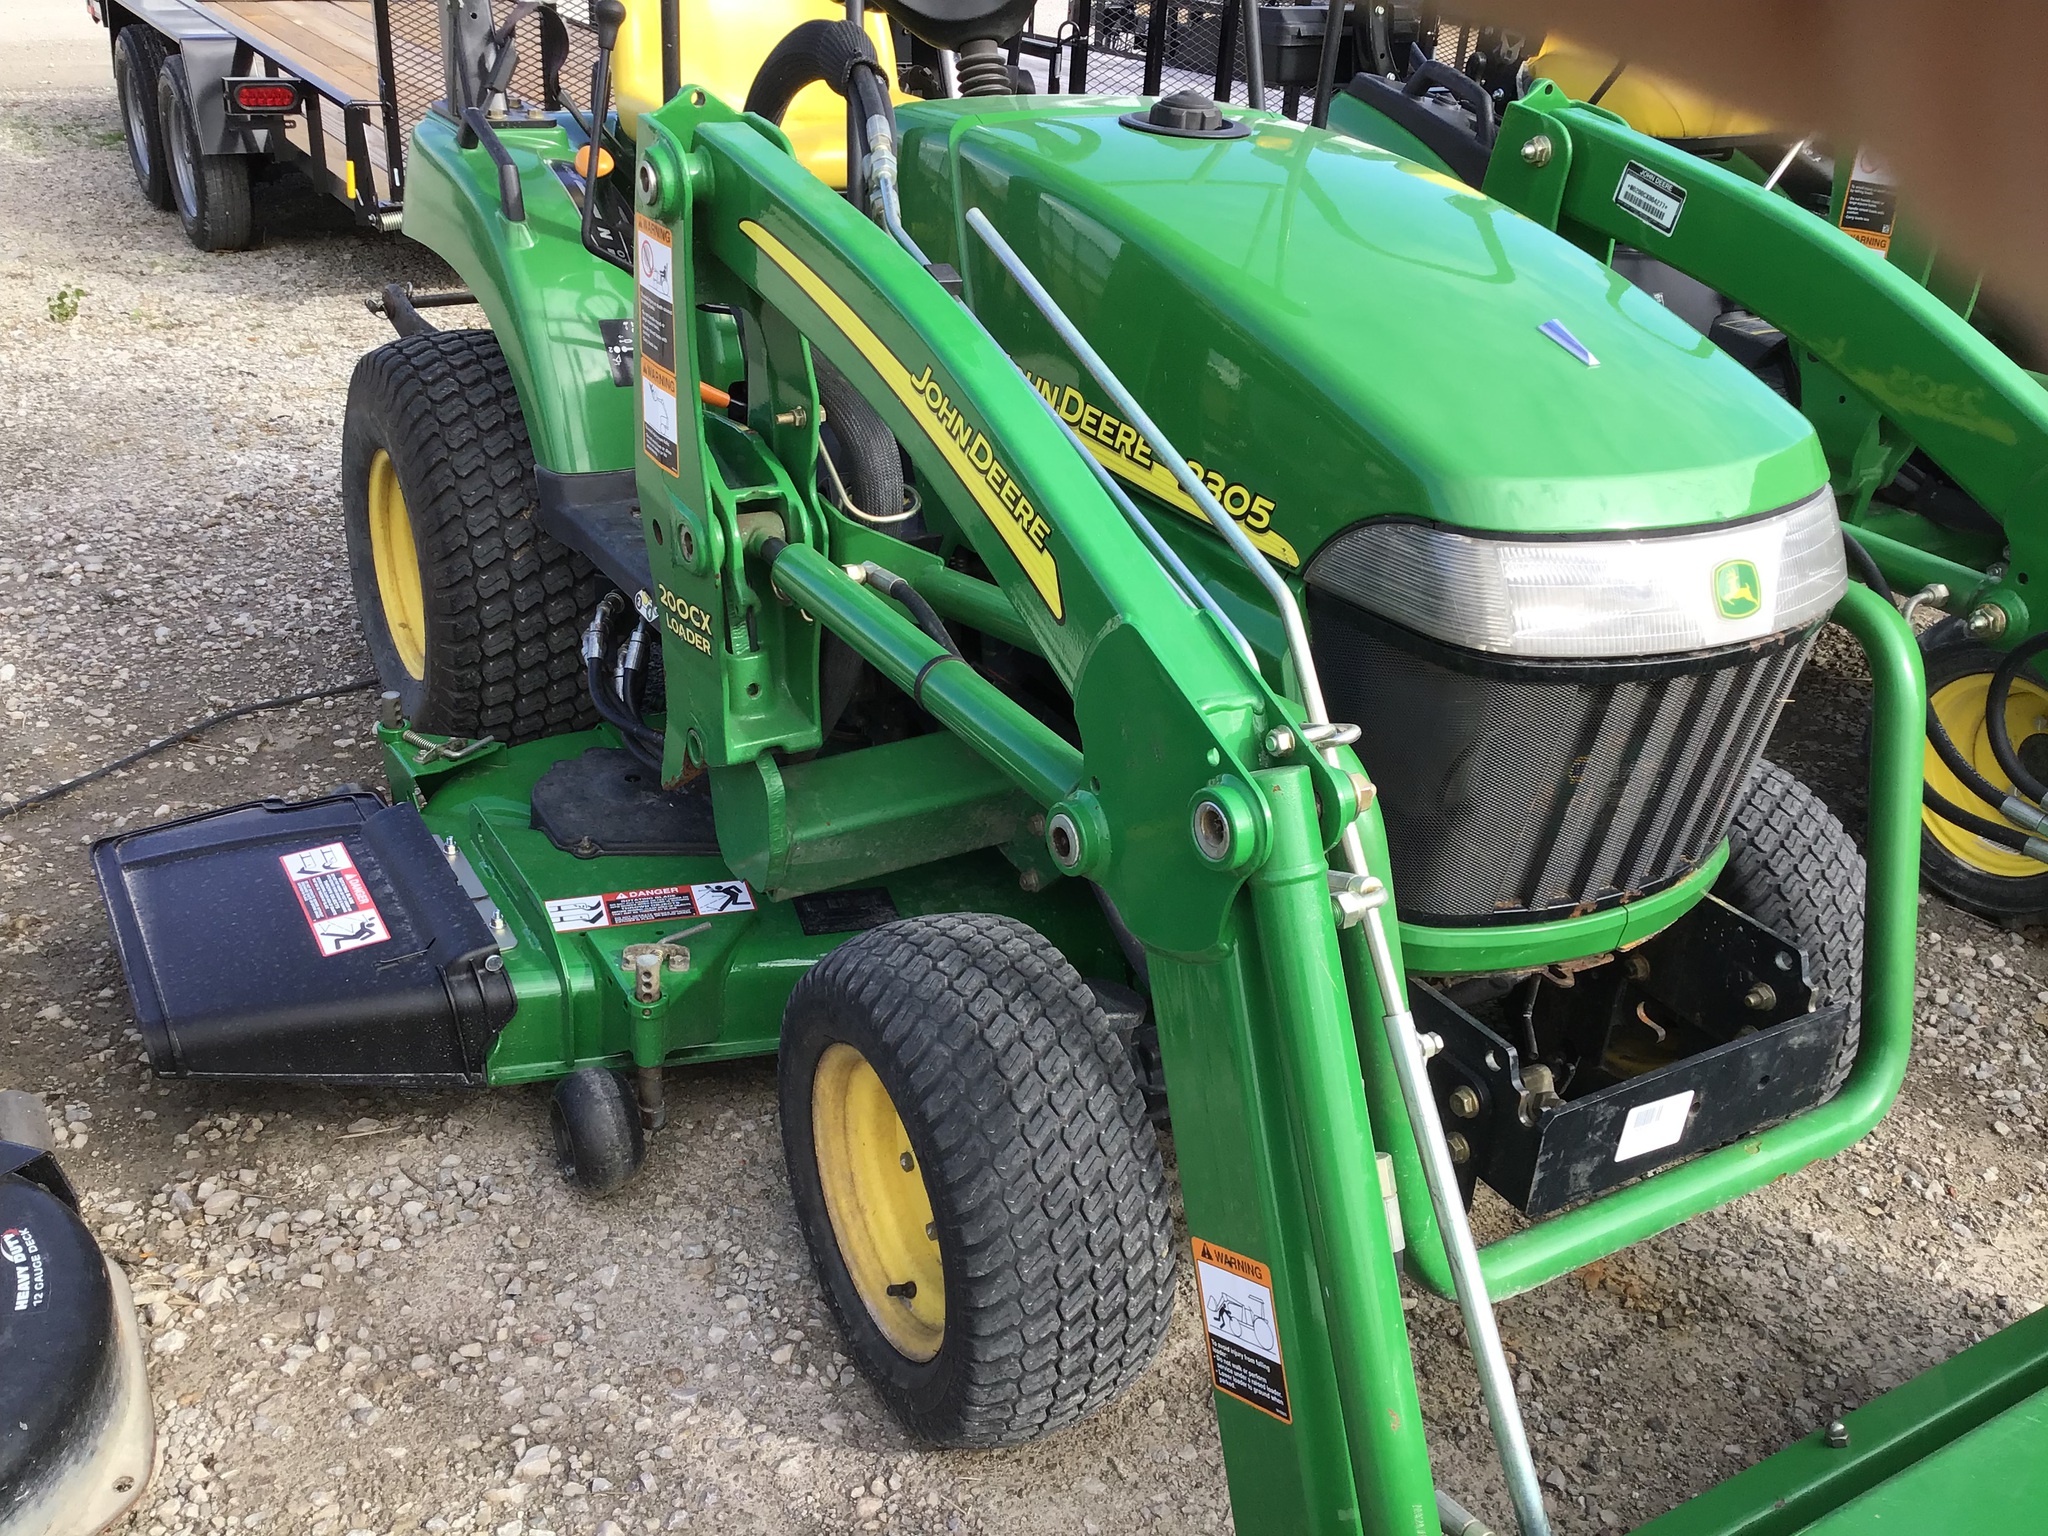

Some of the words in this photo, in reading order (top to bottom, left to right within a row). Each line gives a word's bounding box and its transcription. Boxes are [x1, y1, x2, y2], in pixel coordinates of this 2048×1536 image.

[1640, 170, 1655, 182] JOHN
[1655, 178, 1673, 191] DEERE
[642, 220, 670, 243] WARNING
[648, 364, 674, 392] WARNING
[1058, 385, 1152, 467] DEERE
[911, 366, 973, 448] JOHN
[967, 432, 1051, 549] DEERE
[658, 584, 712, 636] 200CX
[666, 612, 712, 656] LOADER
[348, 878, 370, 904] DANGER
[629, 887, 678, 898] DANGER
[3, 1233, 26, 1264] DUTY
[19, 1228, 38, 1254] DECK
[31, 1254, 44, 1290] GAUGE
[1214, 1249, 1262, 1280] WARNING
[14, 1266, 30, 1311] HEAVY
[33, 1292, 44, 1306] 12
